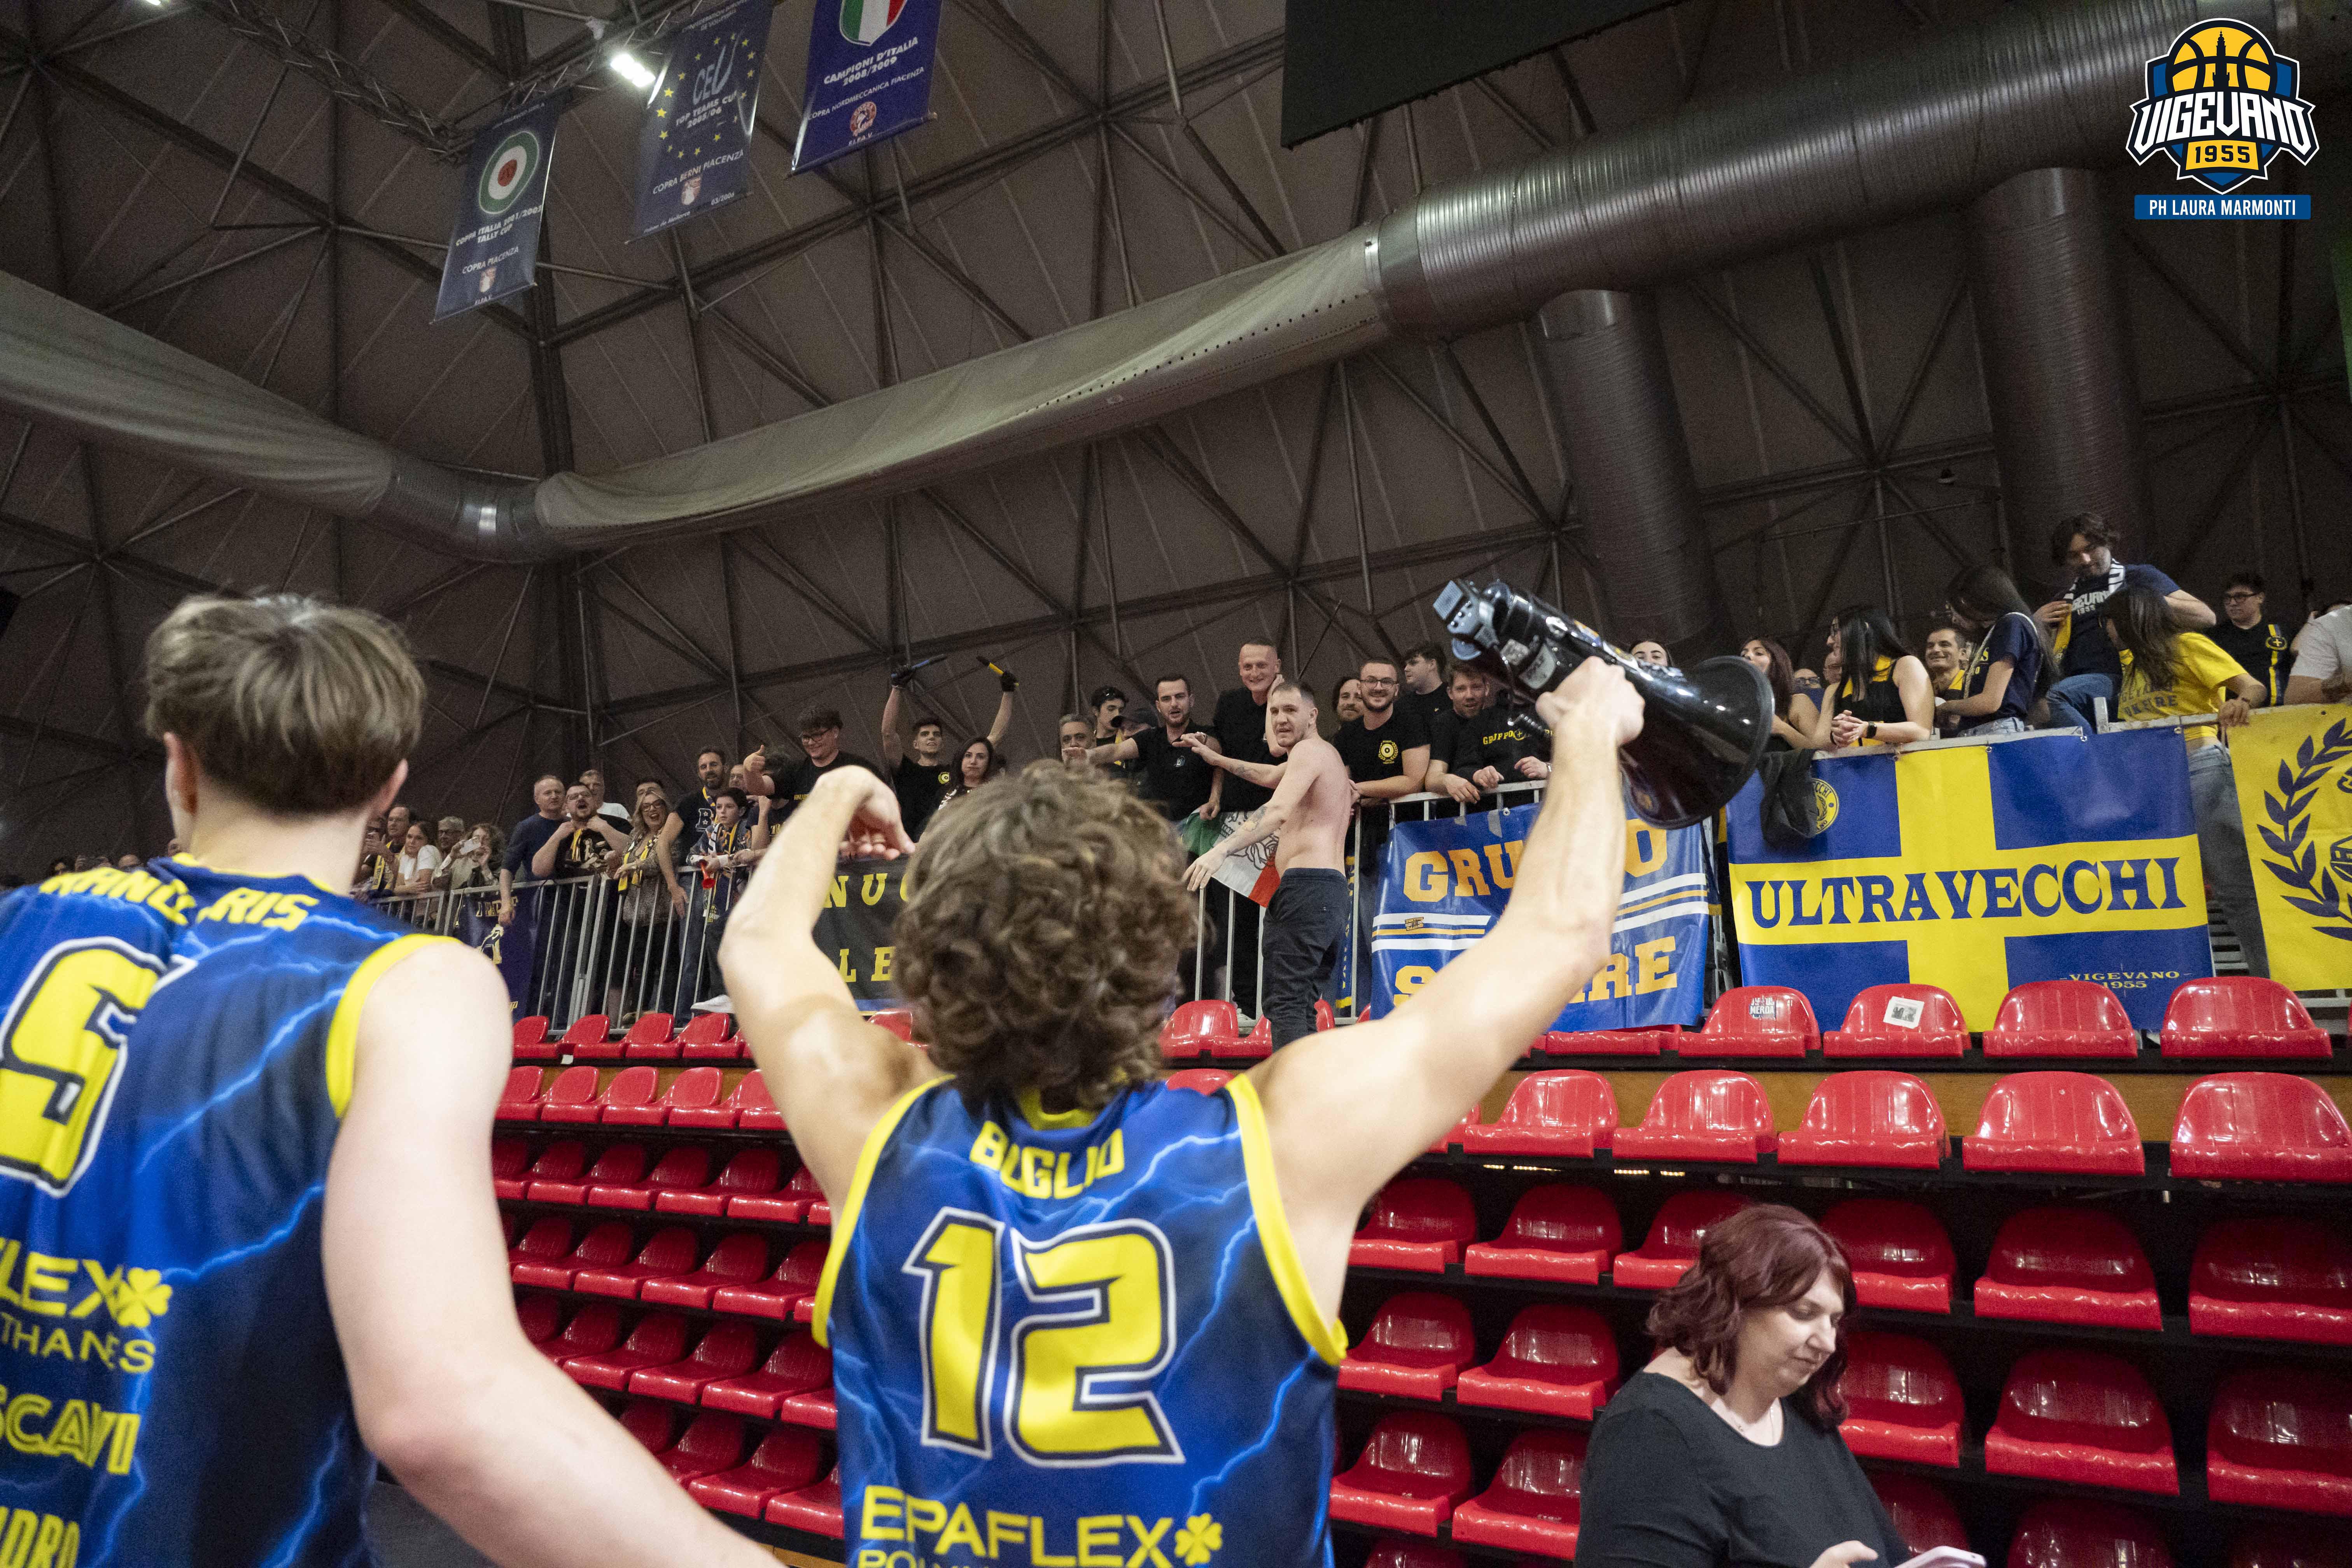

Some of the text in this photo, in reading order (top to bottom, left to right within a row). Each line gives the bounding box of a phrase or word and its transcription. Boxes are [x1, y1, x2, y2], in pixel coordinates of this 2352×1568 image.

[824, 37, 918, 84] CAMPIONI D'ITALIA
[843, 56, 897, 86] 2008/2009
[693, 98, 719, 116] TEAMS
[832, 81, 889, 112] NORDMECCANICA
[891, 66, 924, 85] PIACENZA
[653, 149, 744, 194] COPRA BERNI PIACENZA
[478, 222, 502, 235] ITALIA
[462, 246, 519, 274] COPRA PIACENZA
[1404, 818, 1667, 903] GRUO
[1745, 857, 2187, 929] ULTRAVECCHI
[2069, 971, 2180, 981] VIGEVANO
[2102, 980, 2147, 989] 1955
[1750, 1005, 1774, 1015] MERDA
[970, 1120, 1125, 1199] BUGLIO
[901, 1206, 1186, 1468] 12
[860, 1484, 1174, 1568] EPAFLEX
